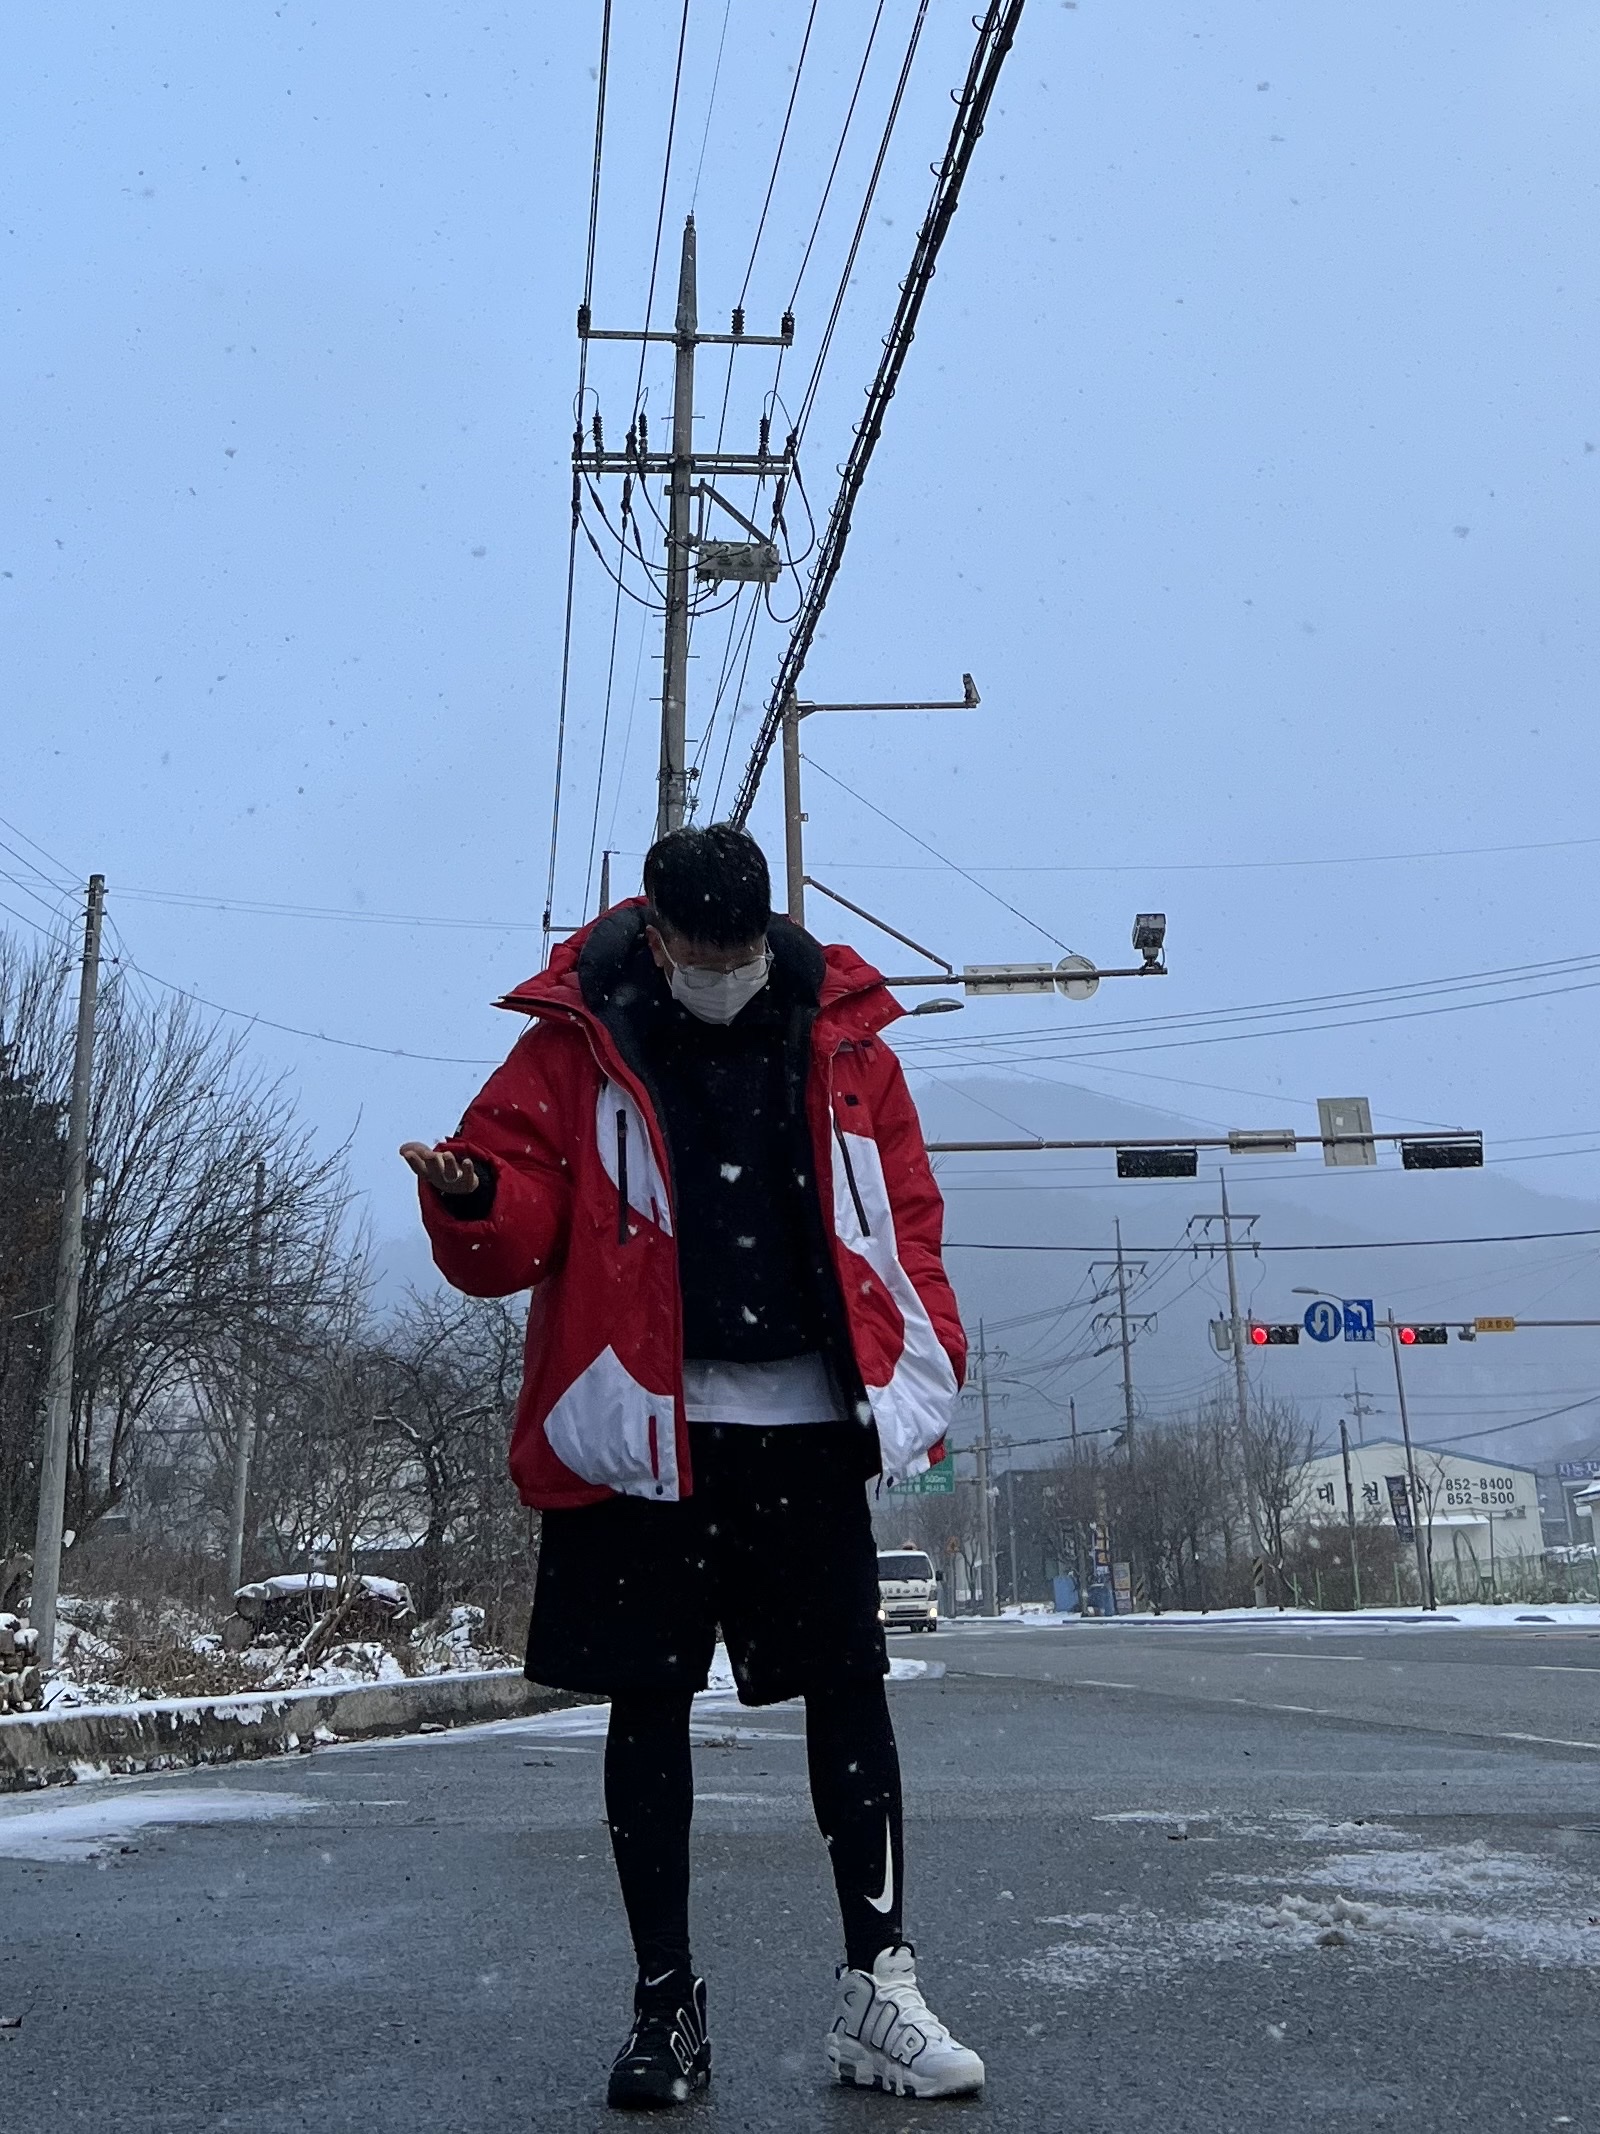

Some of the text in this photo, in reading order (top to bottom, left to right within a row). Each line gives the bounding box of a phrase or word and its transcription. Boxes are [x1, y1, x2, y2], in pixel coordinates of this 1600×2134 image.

[1445, 1477, 1514, 1491] 852-8400
[1447, 1491, 1516, 1506] 852-8500
[832, 1970, 928, 2068] AIR
